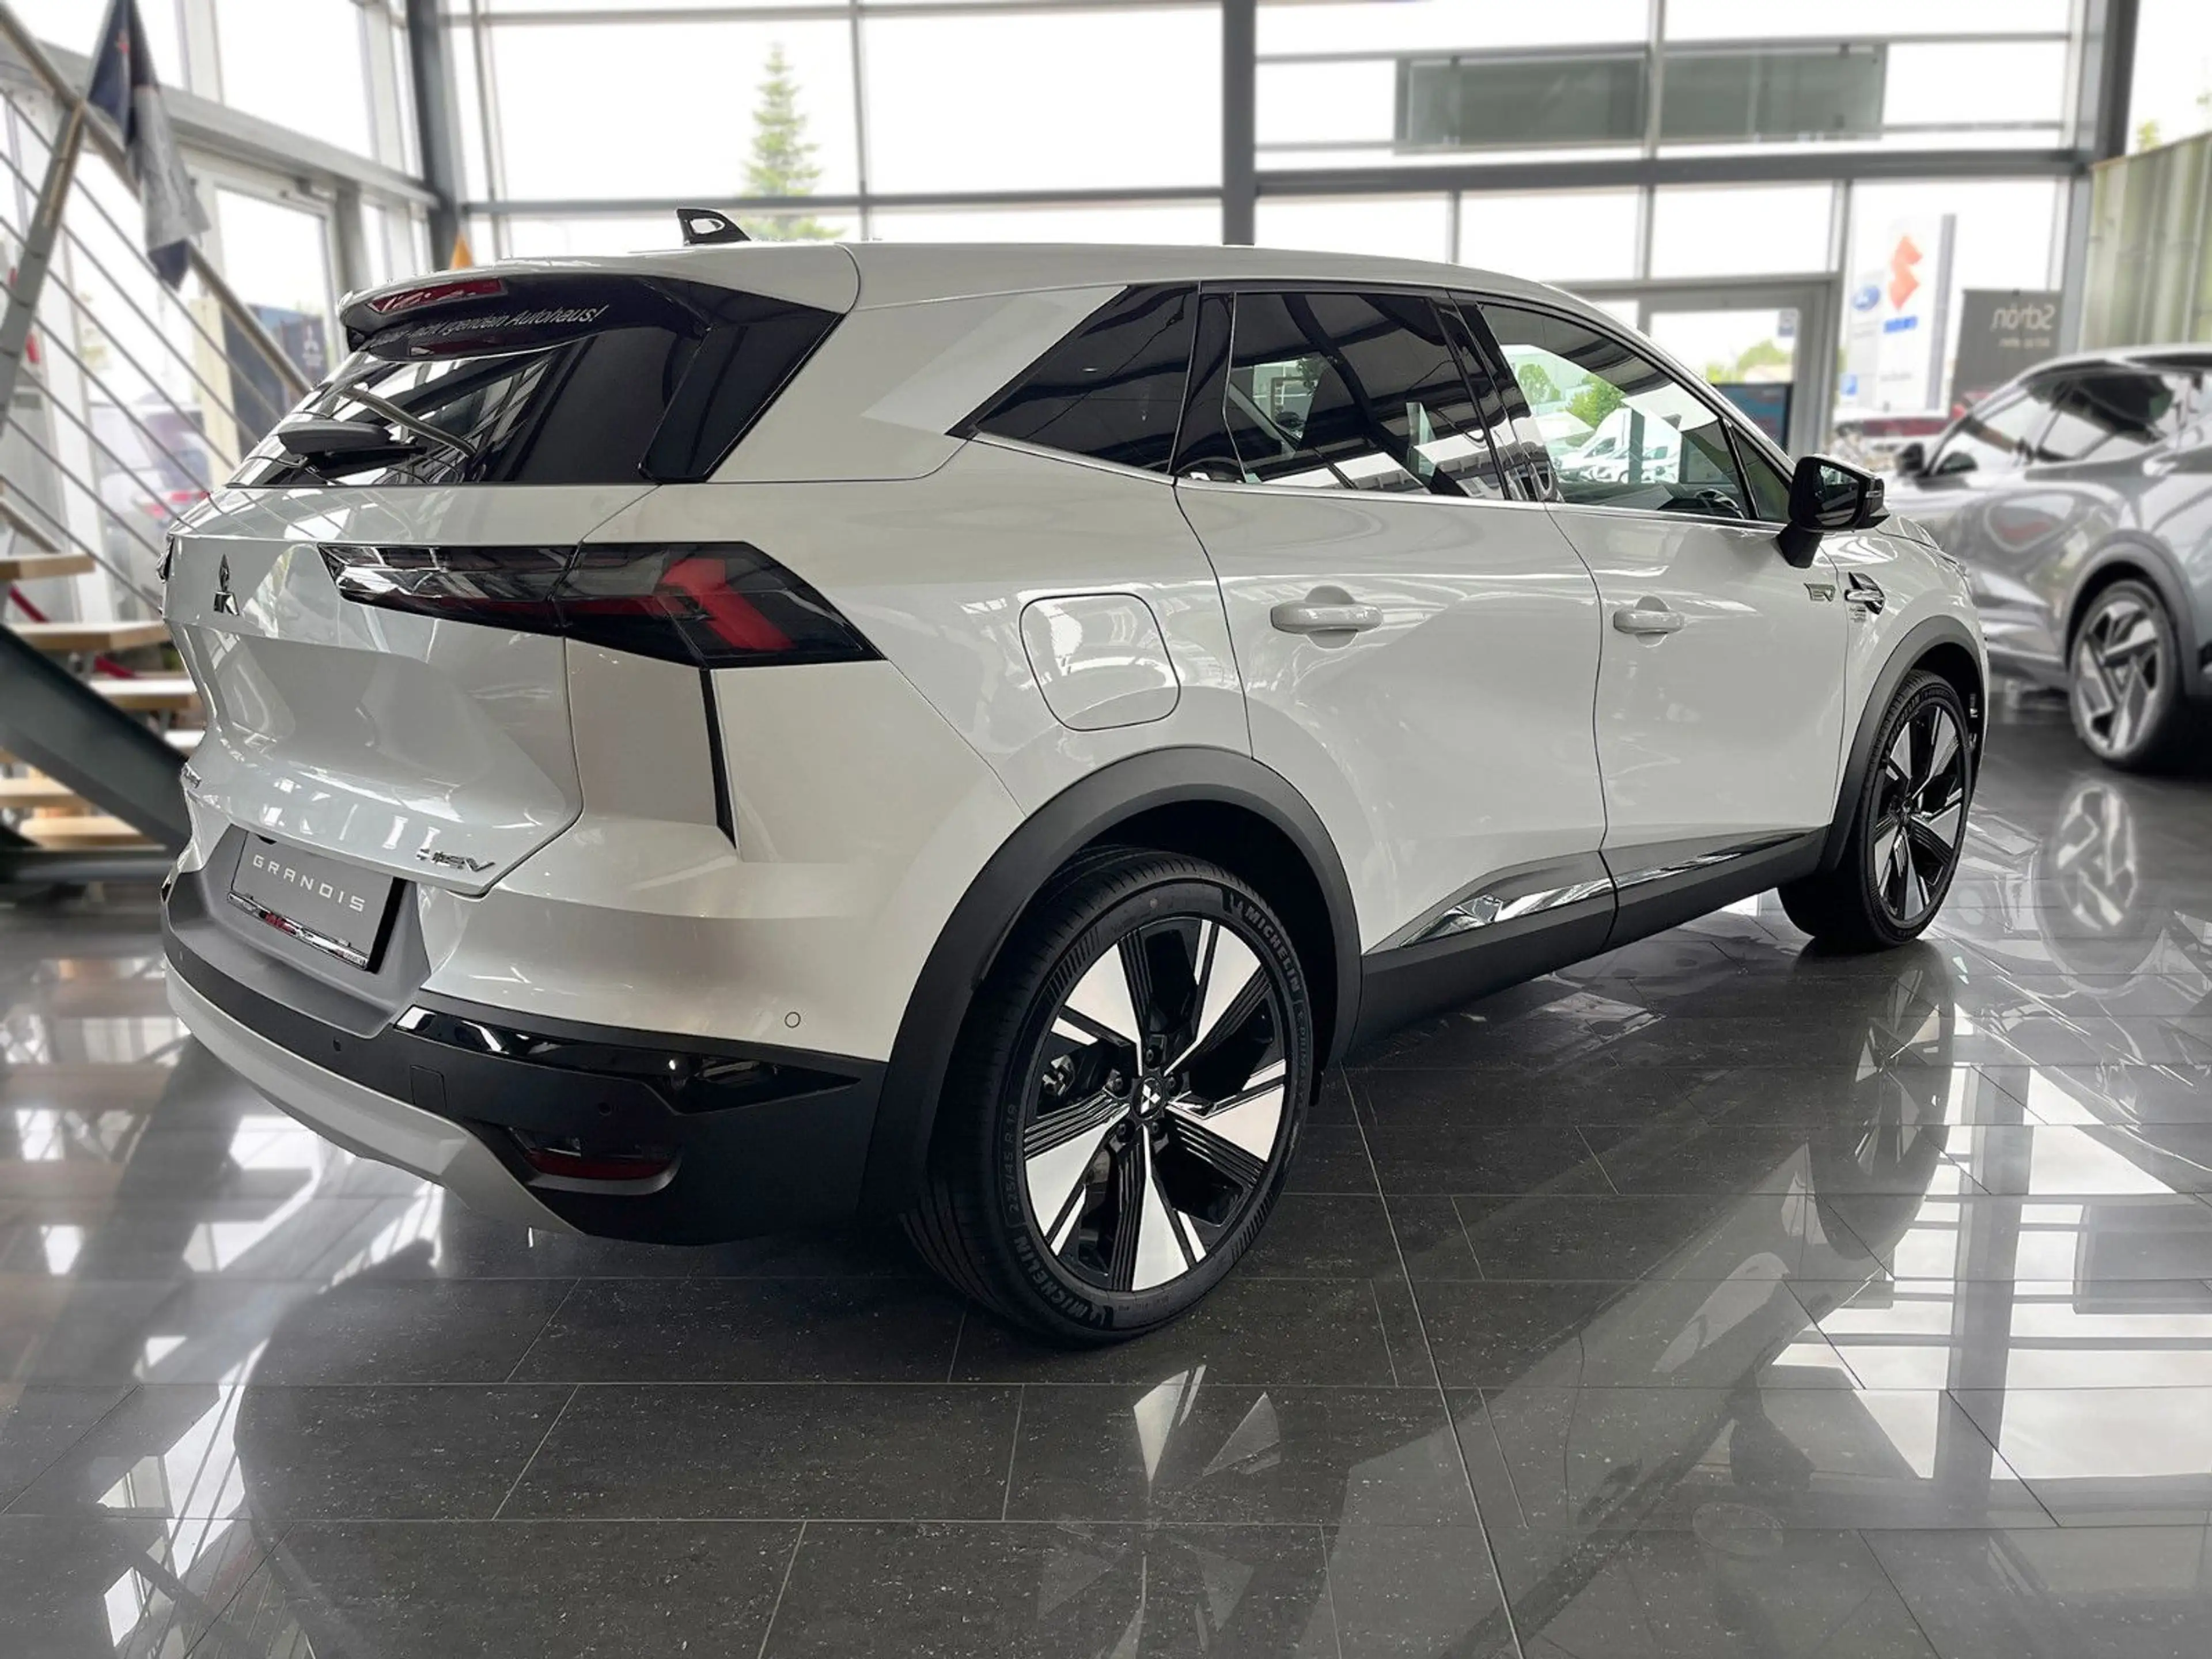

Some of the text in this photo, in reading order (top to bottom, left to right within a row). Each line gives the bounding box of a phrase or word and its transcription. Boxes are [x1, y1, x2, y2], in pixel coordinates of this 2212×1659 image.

[505, 304, 609, 327] Autohaus!
[252, 854, 366, 913] GRANDIS
[1244, 906, 1301, 992] MICHELIN
[1013, 1235, 1089, 1319] MICHELIN
